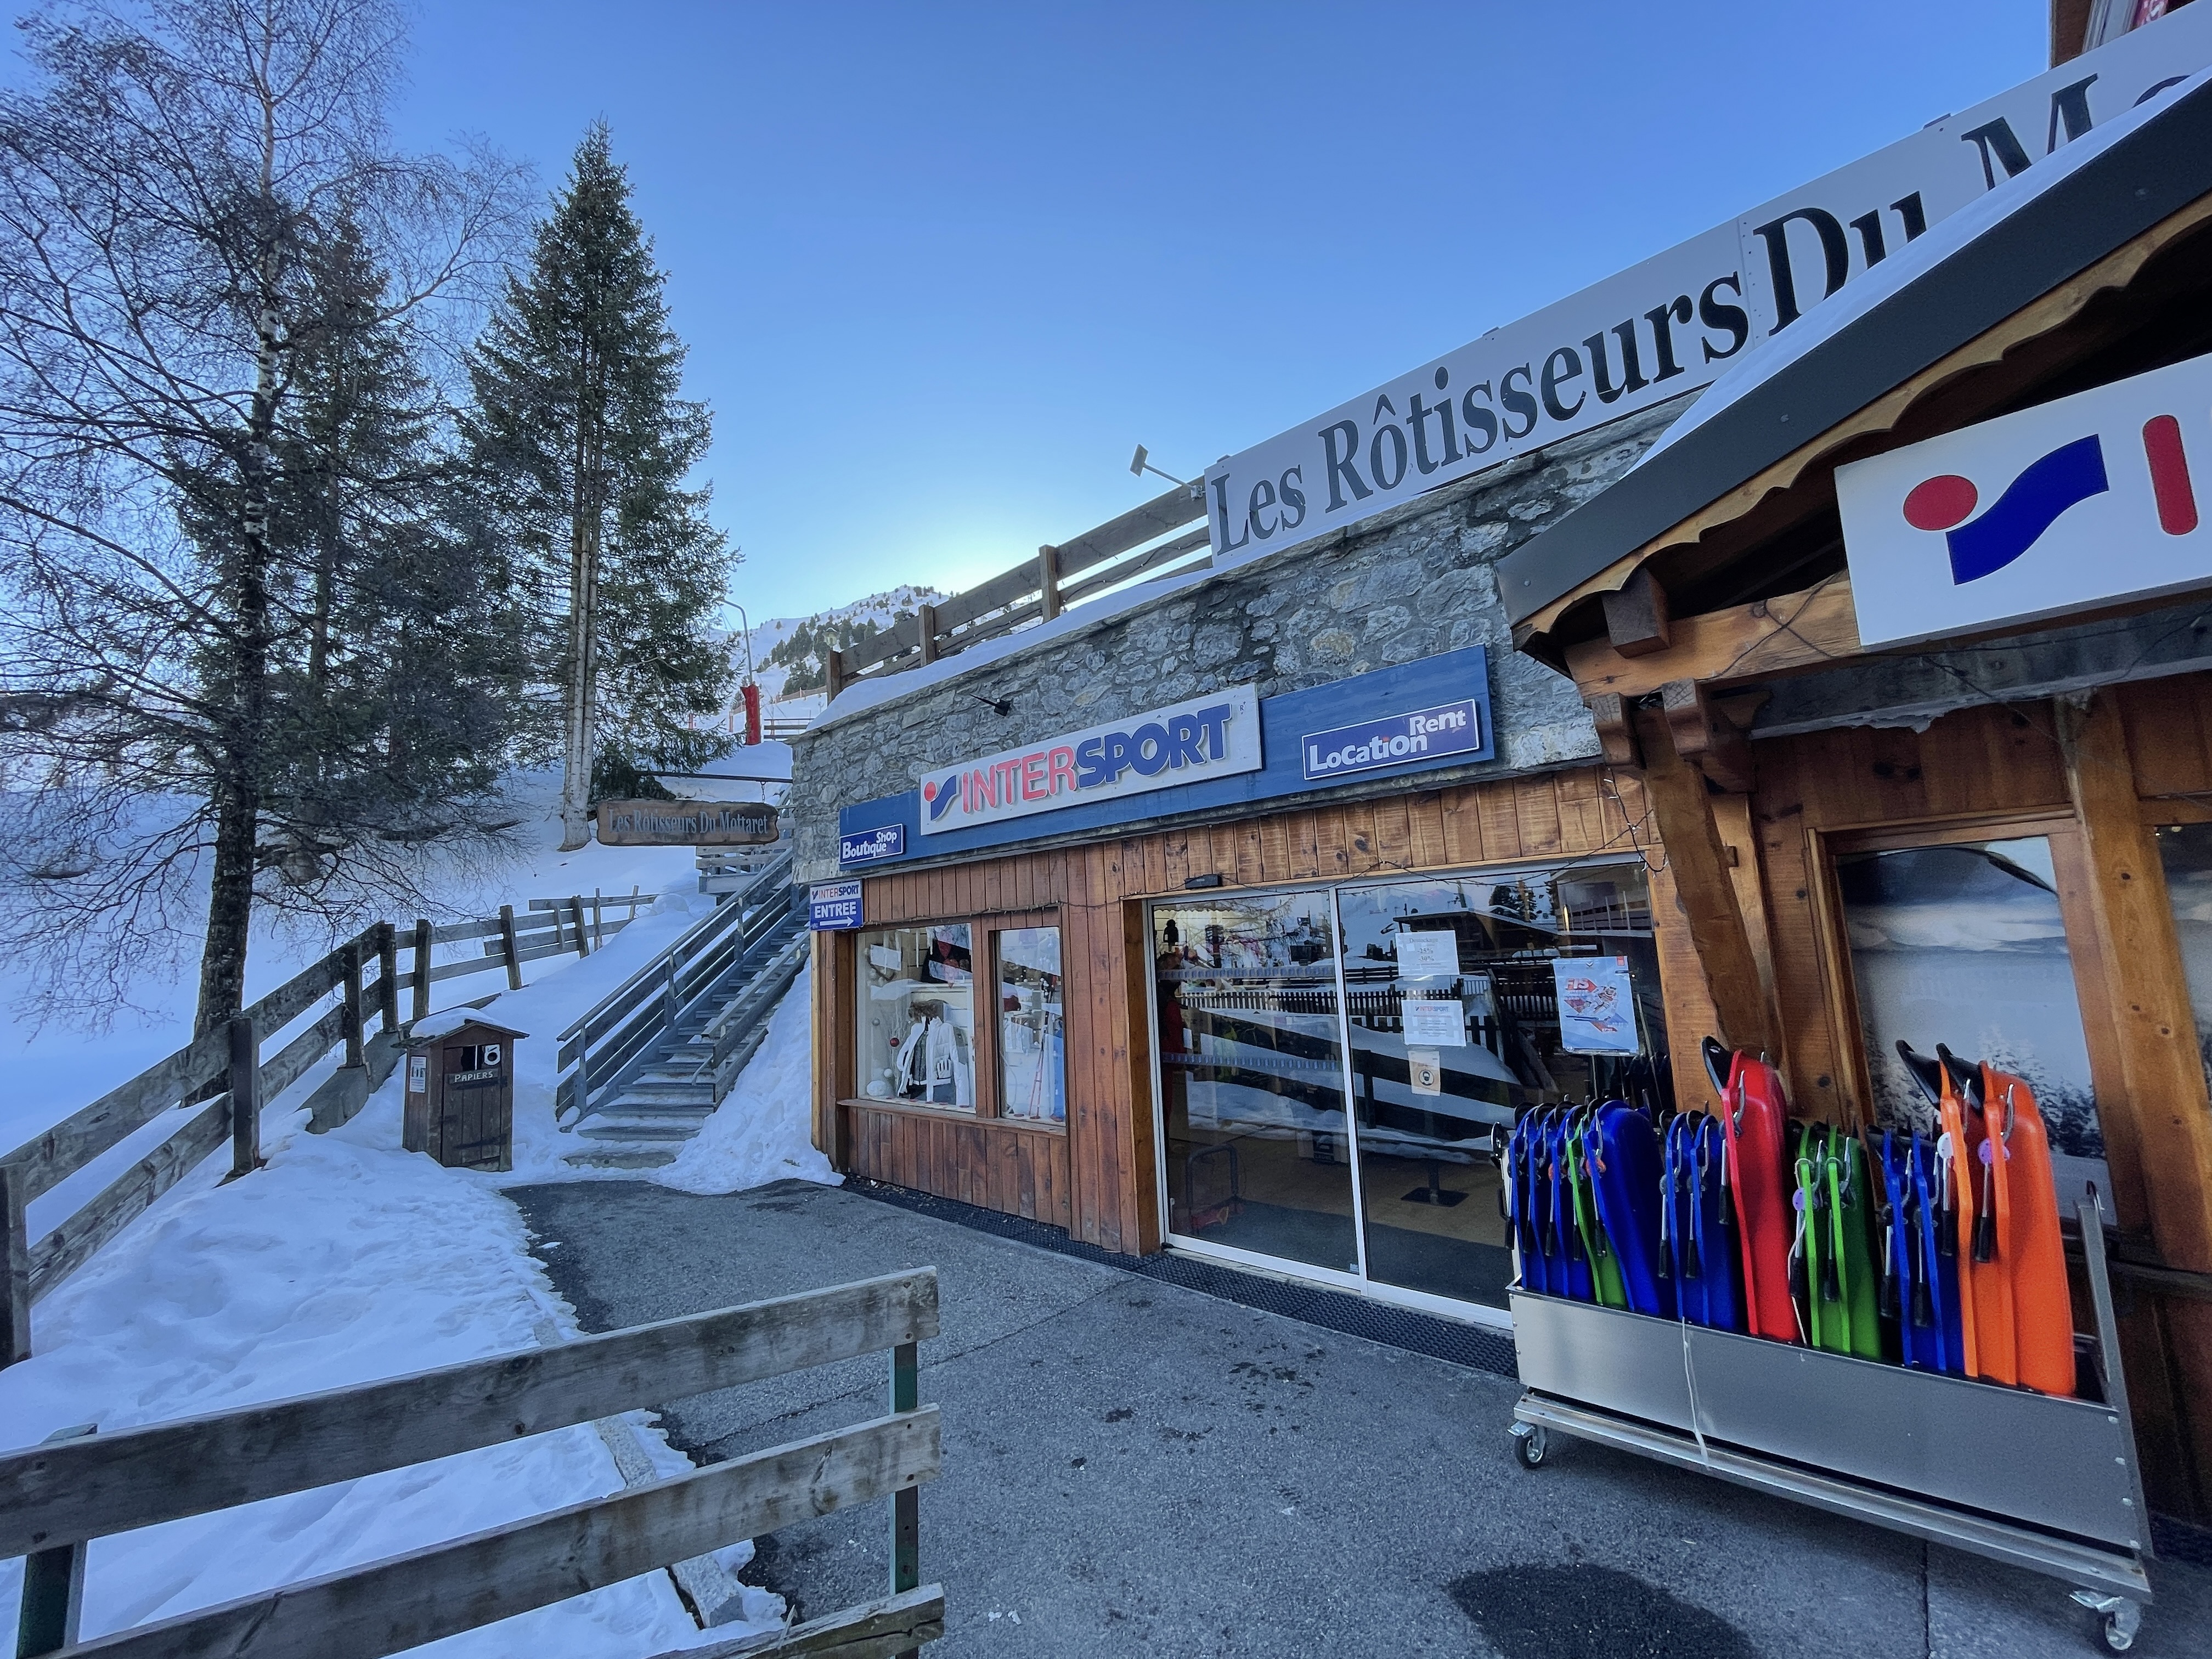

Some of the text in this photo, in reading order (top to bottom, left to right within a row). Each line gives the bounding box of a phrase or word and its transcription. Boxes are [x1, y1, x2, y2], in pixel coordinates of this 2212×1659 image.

[1211, 464, 1306, 557] Les
[1317, 272, 1750, 513] Rôtisseurs
[1753, 191, 1927, 336] Du
[1409, 709, 1466, 736] Rent
[962, 703, 1231, 813] INTERSPORT
[1309, 734, 1427, 772] Location
[608, 808, 769, 834] Les Rôtisseurs Du Mottaret
[876, 831, 898, 844] Shop
[842, 840, 887, 859] Boutique
[819, 884, 859, 899] INTERSPORT
[815, 901, 857, 918] ENTREE
[1566, 978, 1589, 989] FIS
[454, 1070, 493, 1082] PAPIERS
